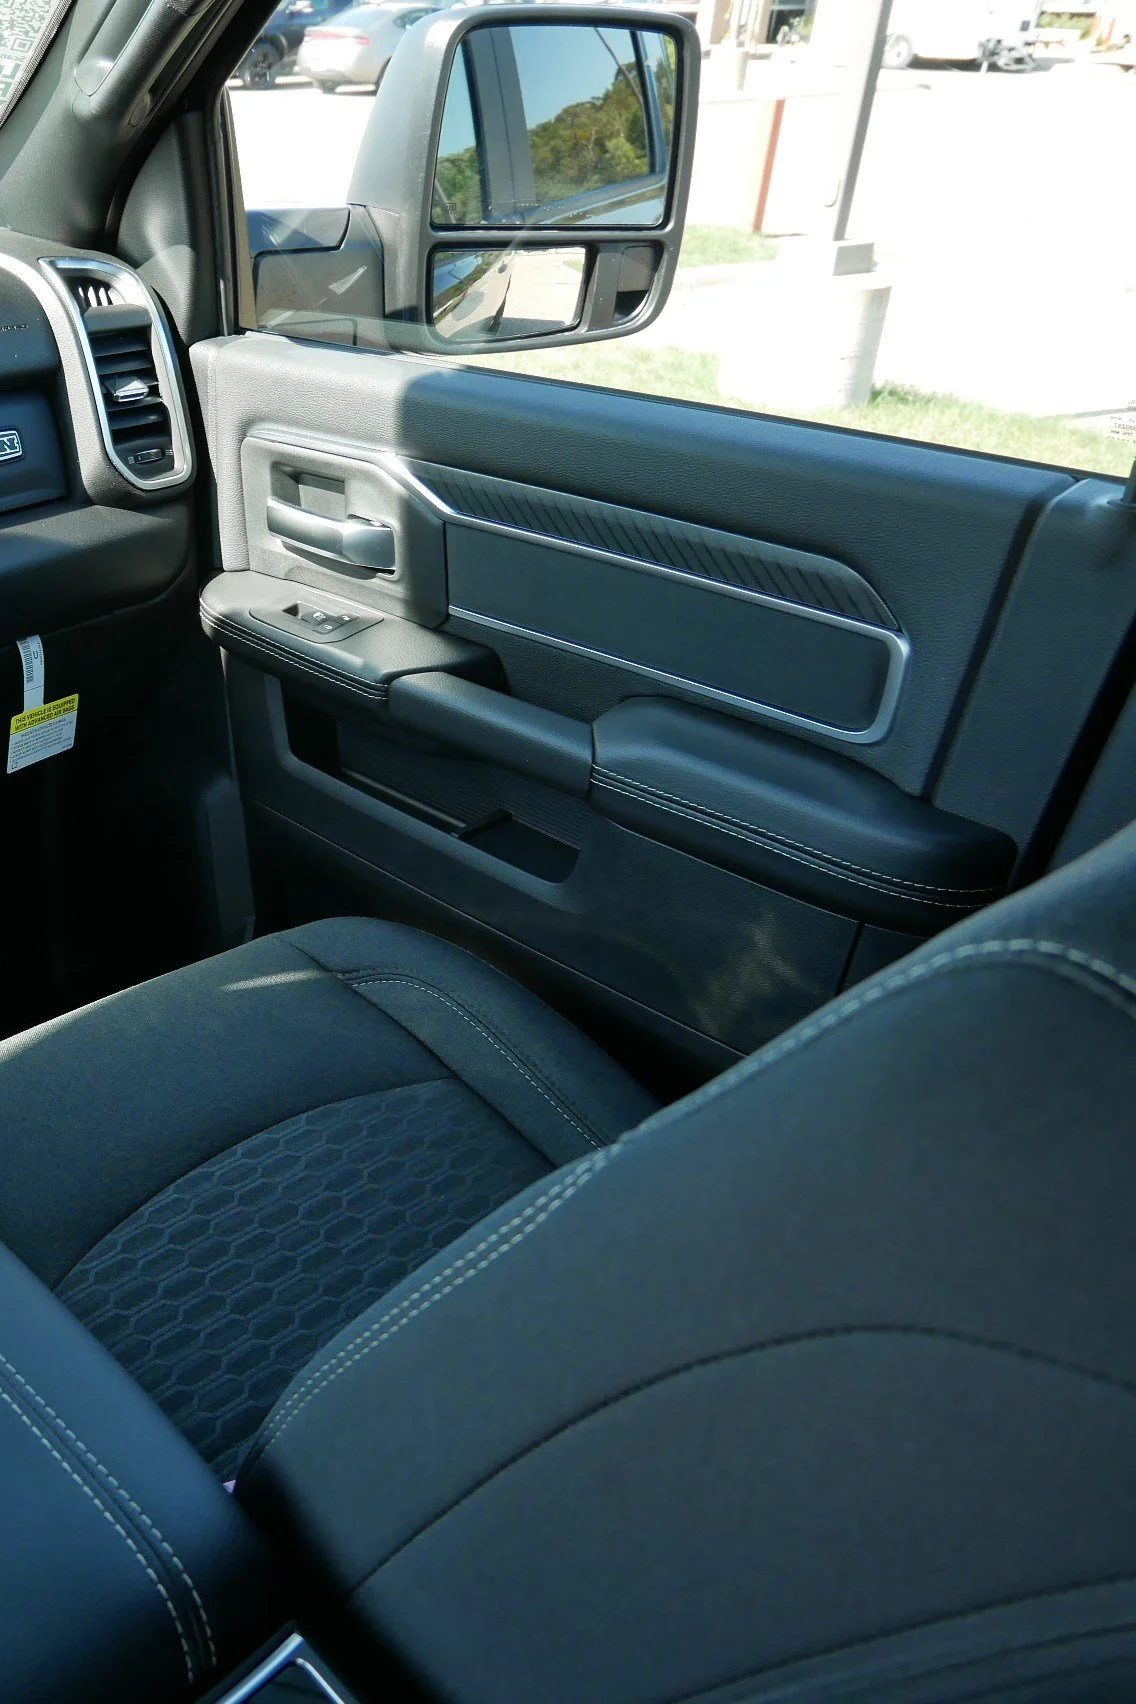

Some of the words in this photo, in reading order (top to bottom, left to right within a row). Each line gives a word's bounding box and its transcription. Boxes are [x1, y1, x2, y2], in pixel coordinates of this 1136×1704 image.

[15, 715, 27, 725] THIS
[27, 709, 46, 721] VEHICLE
[53, 698, 76, 711] EQUIPPED
[27, 713, 53, 726] ADVANCED
